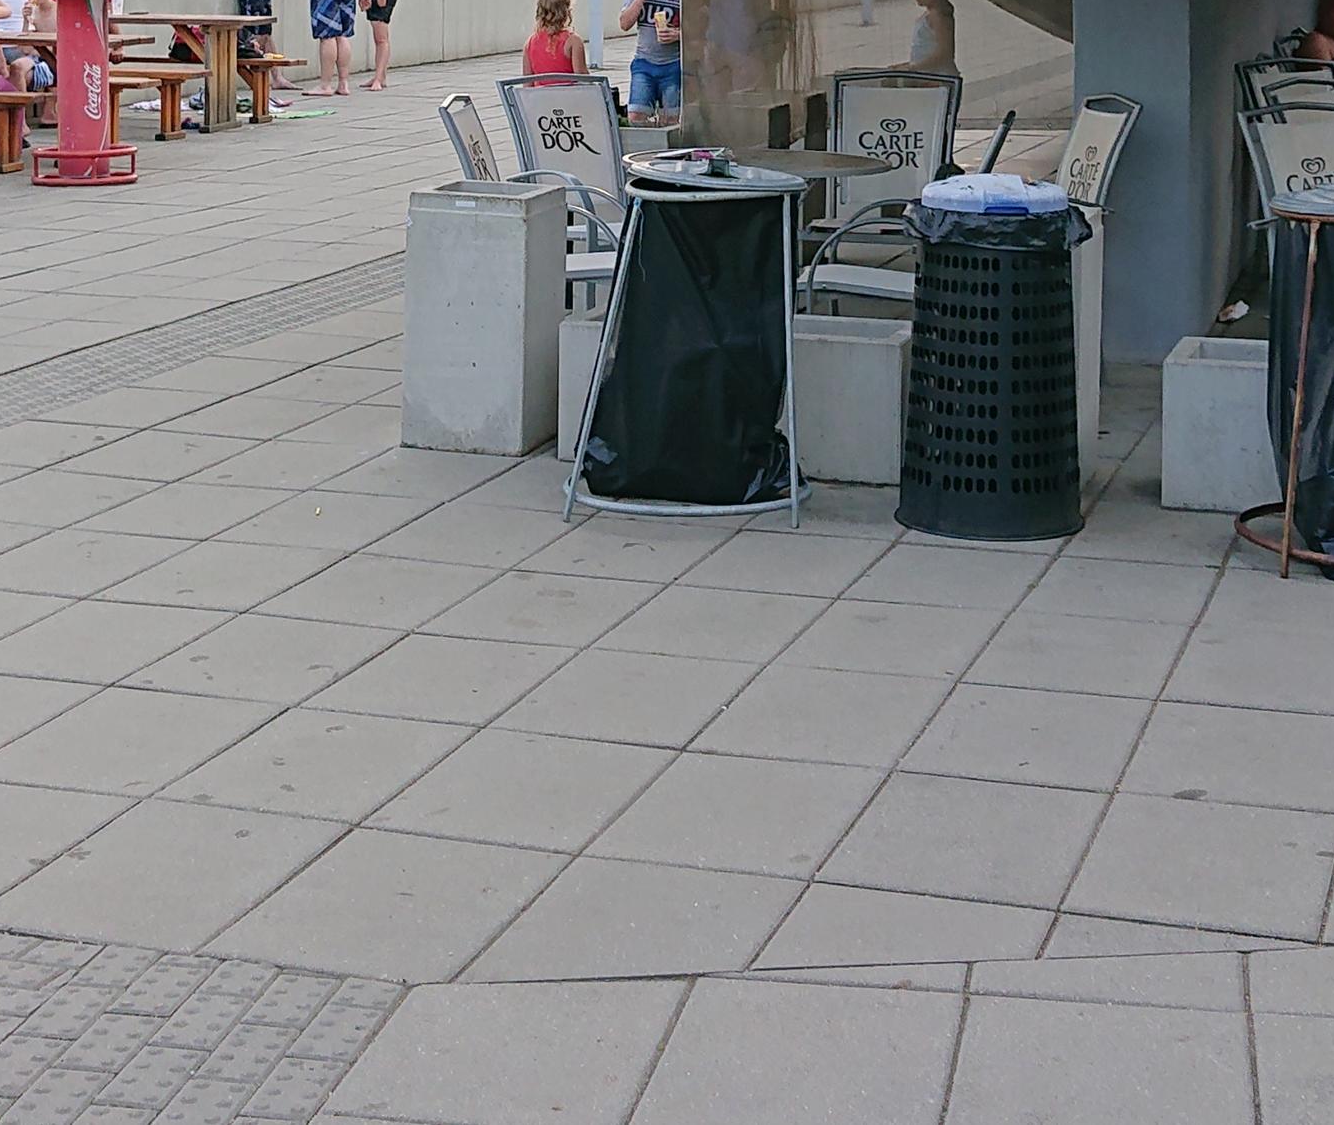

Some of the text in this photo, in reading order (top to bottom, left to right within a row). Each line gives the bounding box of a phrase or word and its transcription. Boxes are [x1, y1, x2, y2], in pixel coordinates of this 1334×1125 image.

[538, 116, 582, 131] CARTE
[859, 131, 923, 152] CARTE
[1071, 159, 1101, 181] CARTE
